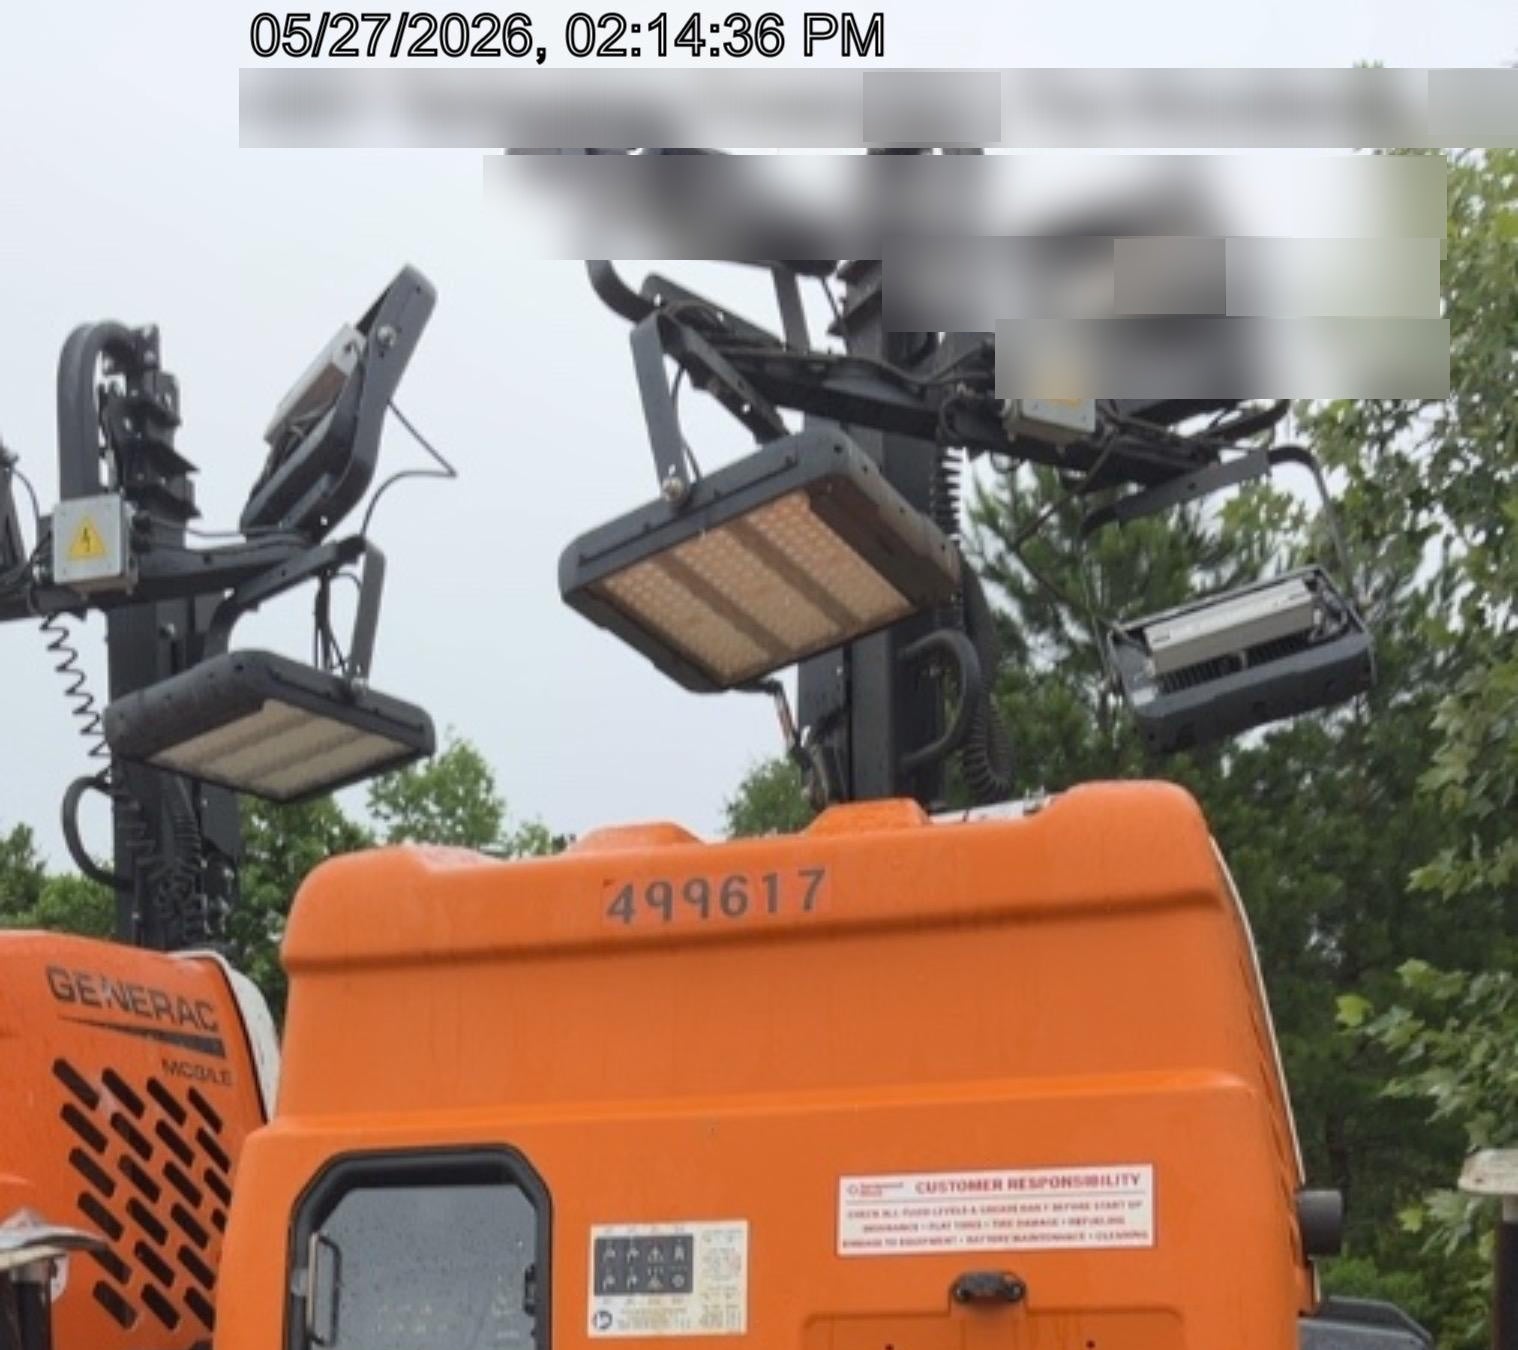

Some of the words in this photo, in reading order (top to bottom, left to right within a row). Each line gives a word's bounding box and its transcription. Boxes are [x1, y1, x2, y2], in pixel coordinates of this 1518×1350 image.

[606, 869, 826, 925] 499617
[48, 964, 219, 1032] GENERAC
[914, 1177, 1002, 1195] CUSTOMER
[1007, 1171, 1140, 1191] RESPONSIBILITY
